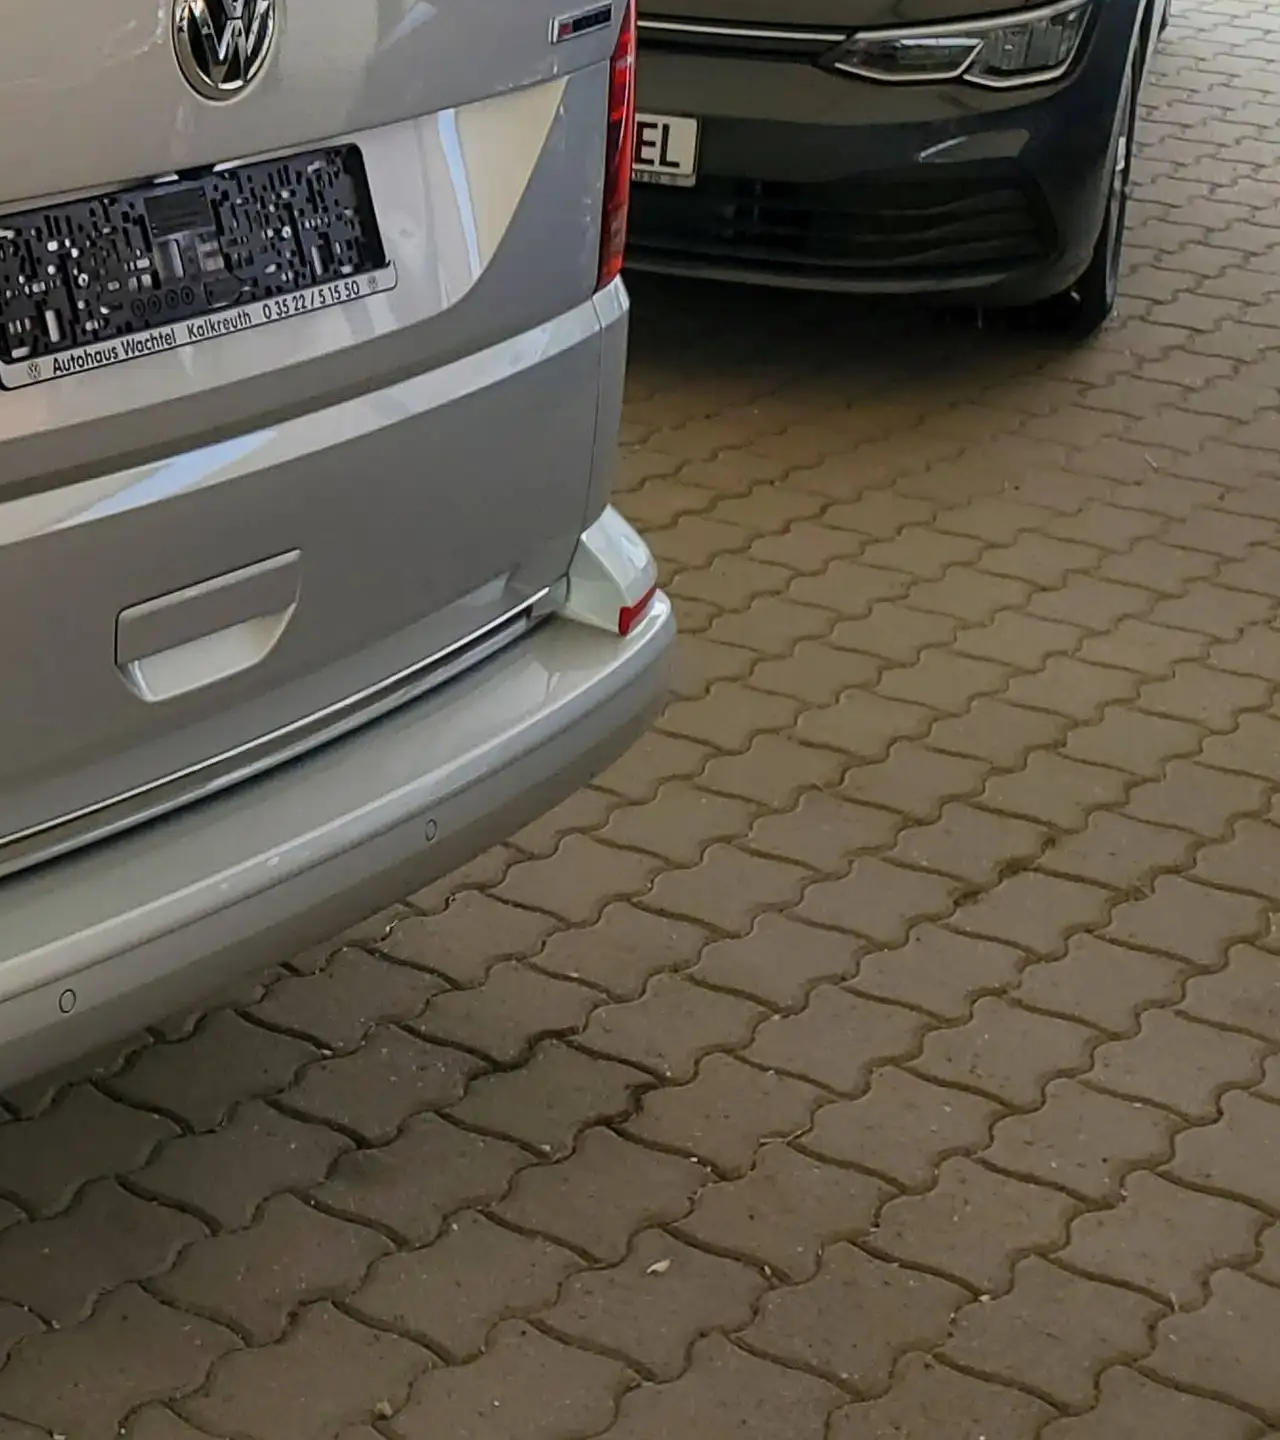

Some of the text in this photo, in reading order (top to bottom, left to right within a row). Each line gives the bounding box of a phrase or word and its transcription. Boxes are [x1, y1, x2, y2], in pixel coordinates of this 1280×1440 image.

[52, 345, 119, 375] Autohaus
[121, 327, 177, 357] Wachtel
[186, 310, 252, 340] Kalkreuth
[275, 300, 289, 317] 35
[292, 295, 307, 313] 22
[318, 290, 327, 305] 5
[328, 285, 342, 302] 15
[344, 279, 361, 298] 50
